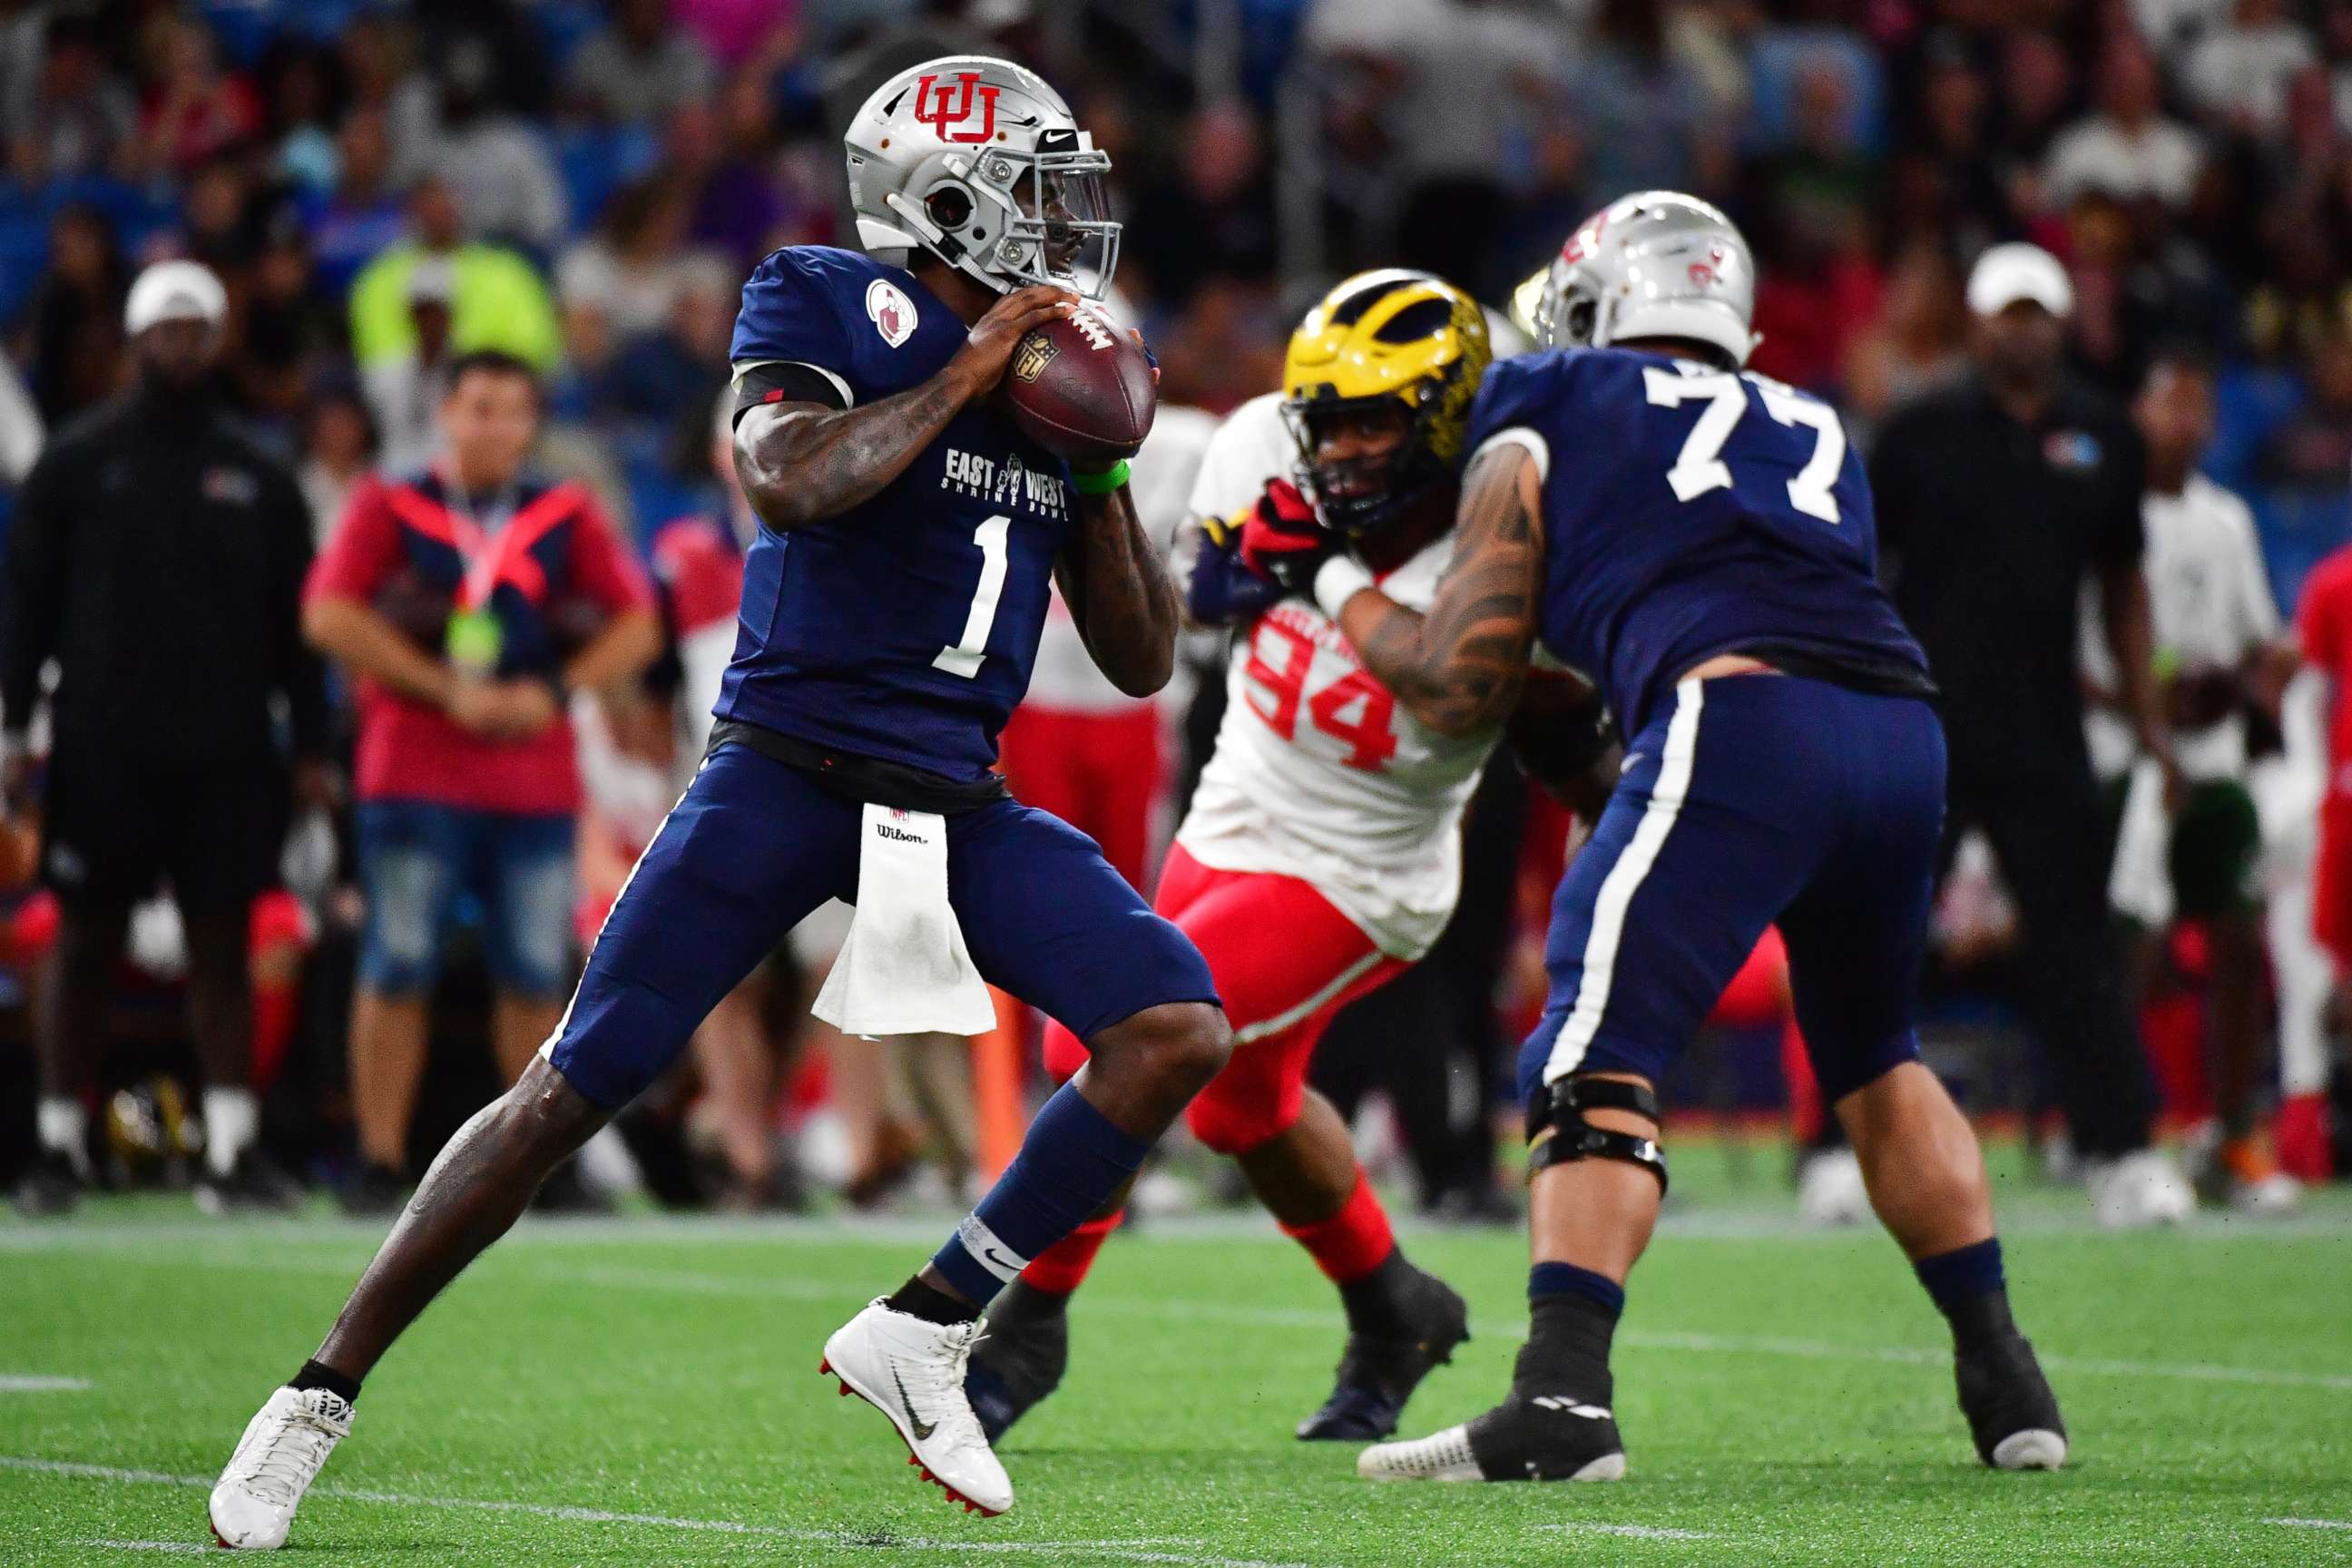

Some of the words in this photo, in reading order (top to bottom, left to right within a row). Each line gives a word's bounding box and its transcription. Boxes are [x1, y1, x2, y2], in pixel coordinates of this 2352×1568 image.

[940, 476, 1017, 506] SHRINE
[1028, 501, 1069, 522] BOWL
[946, 448, 995, 490] EAST
[1024, 468, 1066, 509] WEST
[1642, 366, 1847, 525] 77
[931, 514, 1012, 679] 1
[1244, 612, 1398, 773] 94
[877, 823, 924, 844] Wilson
